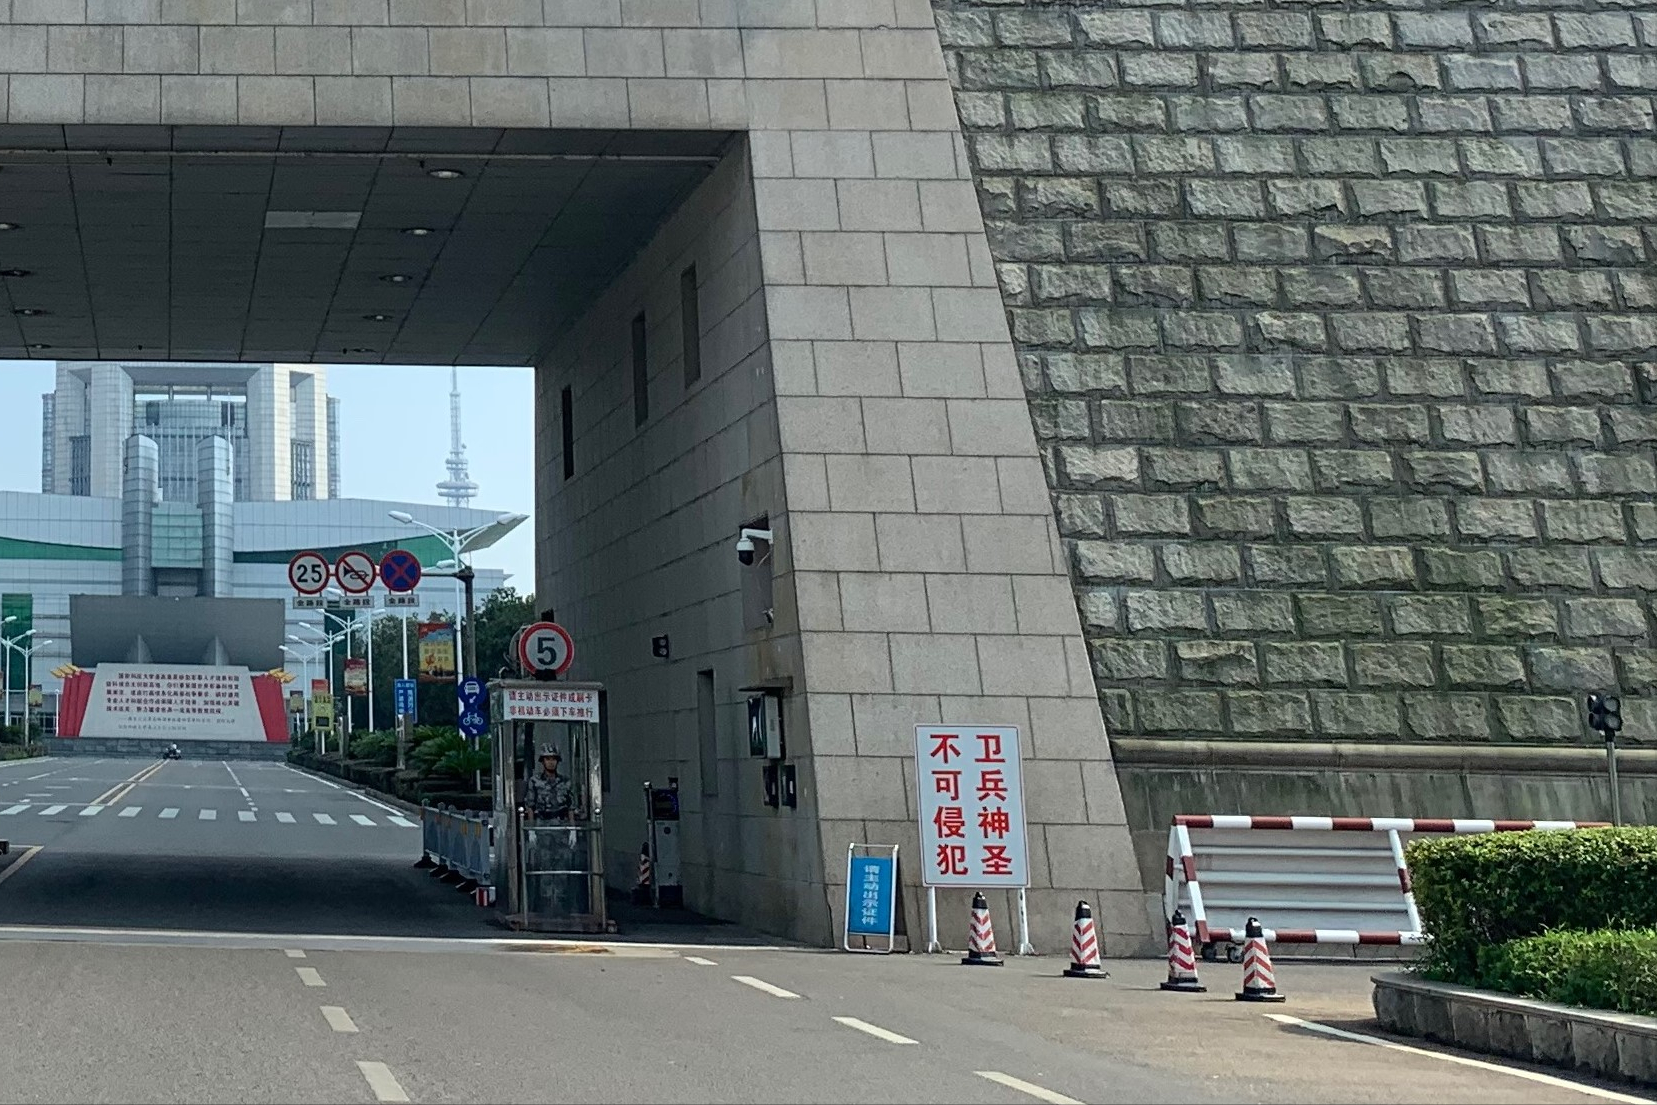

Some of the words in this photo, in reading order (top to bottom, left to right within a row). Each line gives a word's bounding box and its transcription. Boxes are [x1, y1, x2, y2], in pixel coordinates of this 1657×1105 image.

[296, 564, 322, 583] 25
[296, 599, 324, 607] 全路段
[343, 598, 370, 606] 全路段
[537, 636, 557, 666] 5
[509, 705, 594, 718] 非机动车必须下车推行
[929, 734, 969, 876] 不可侵犯
[974, 734, 1013, 876] 卫兵神圣
[862, 865, 881, 926] 请主动出示证件
